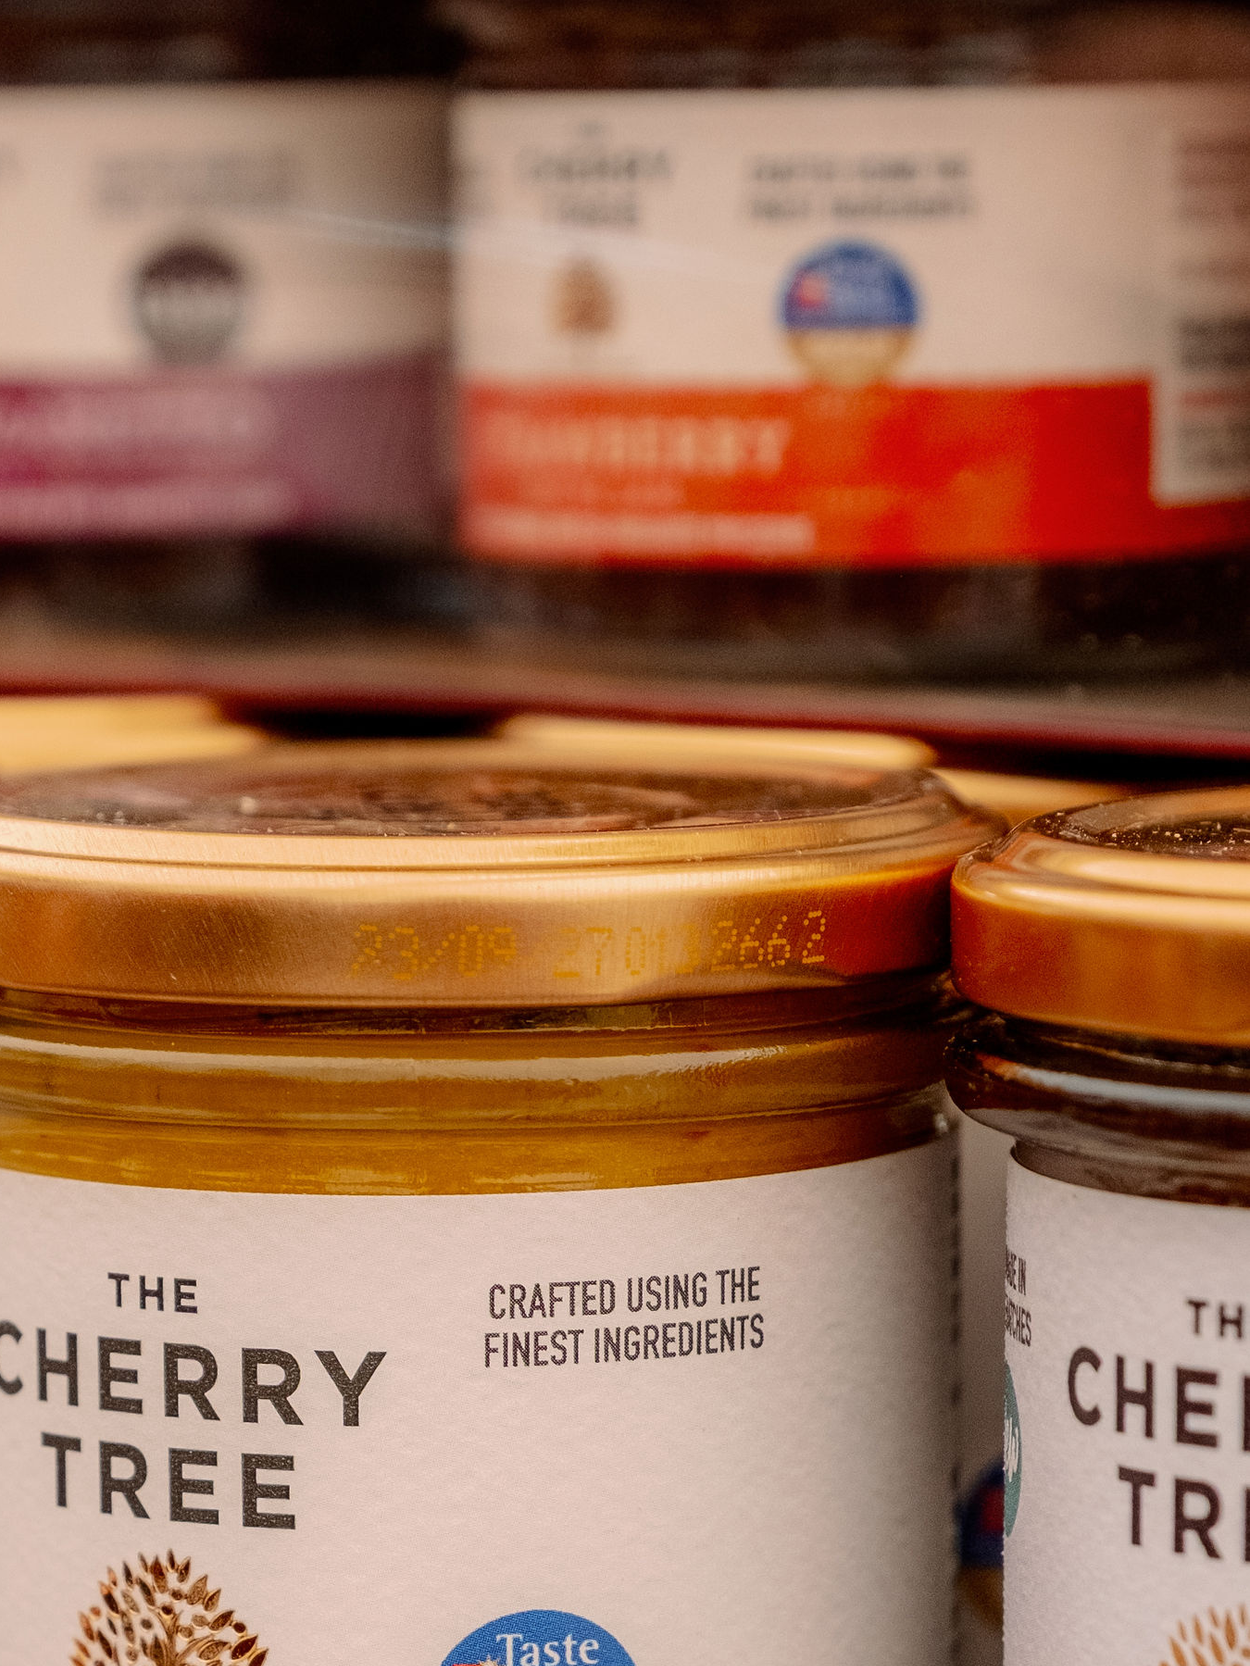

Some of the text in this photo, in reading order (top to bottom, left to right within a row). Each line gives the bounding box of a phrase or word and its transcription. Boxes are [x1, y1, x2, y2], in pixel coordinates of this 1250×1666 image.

[107, 1271, 199, 1314] THE
[488, 1265, 761, 1320] CRAFTED USING THE
[484, 1313, 765, 1369] FINEST INGREDIENTS
[1067, 1345, 1250, 1453] CHE
[40, 1431, 297, 1531] TREE
[1117, 1464, 1250, 1563] TR
